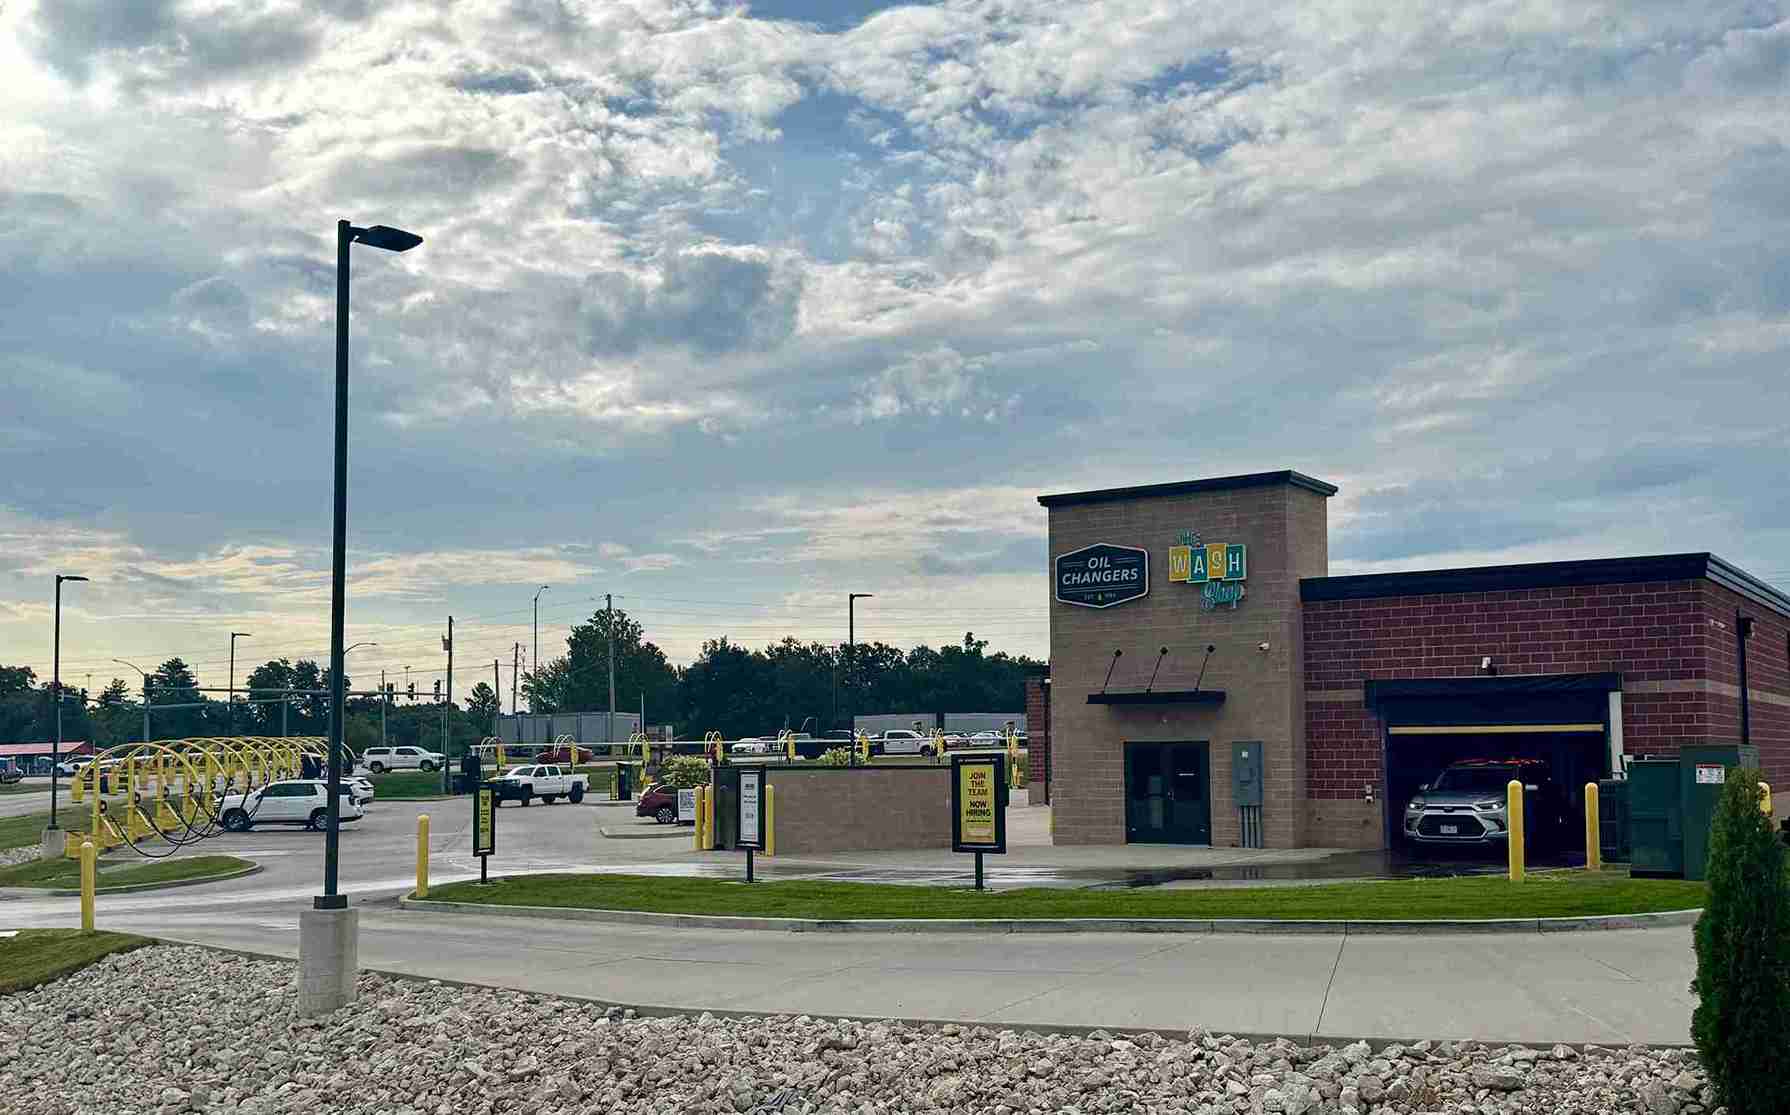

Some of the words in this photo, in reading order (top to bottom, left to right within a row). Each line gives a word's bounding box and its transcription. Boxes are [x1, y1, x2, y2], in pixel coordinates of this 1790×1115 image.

[1088, 556, 1111, 569] OIL
[1171, 550, 1241, 575] WASH
[1062, 568, 1138, 585] CHANGERS
[968, 771, 986, 780] JOIN
[970, 780, 985, 788] THE
[968, 788, 988, 796] TEAM
[969, 799, 987, 809] NOW
[966, 809, 991, 818] HIRING
